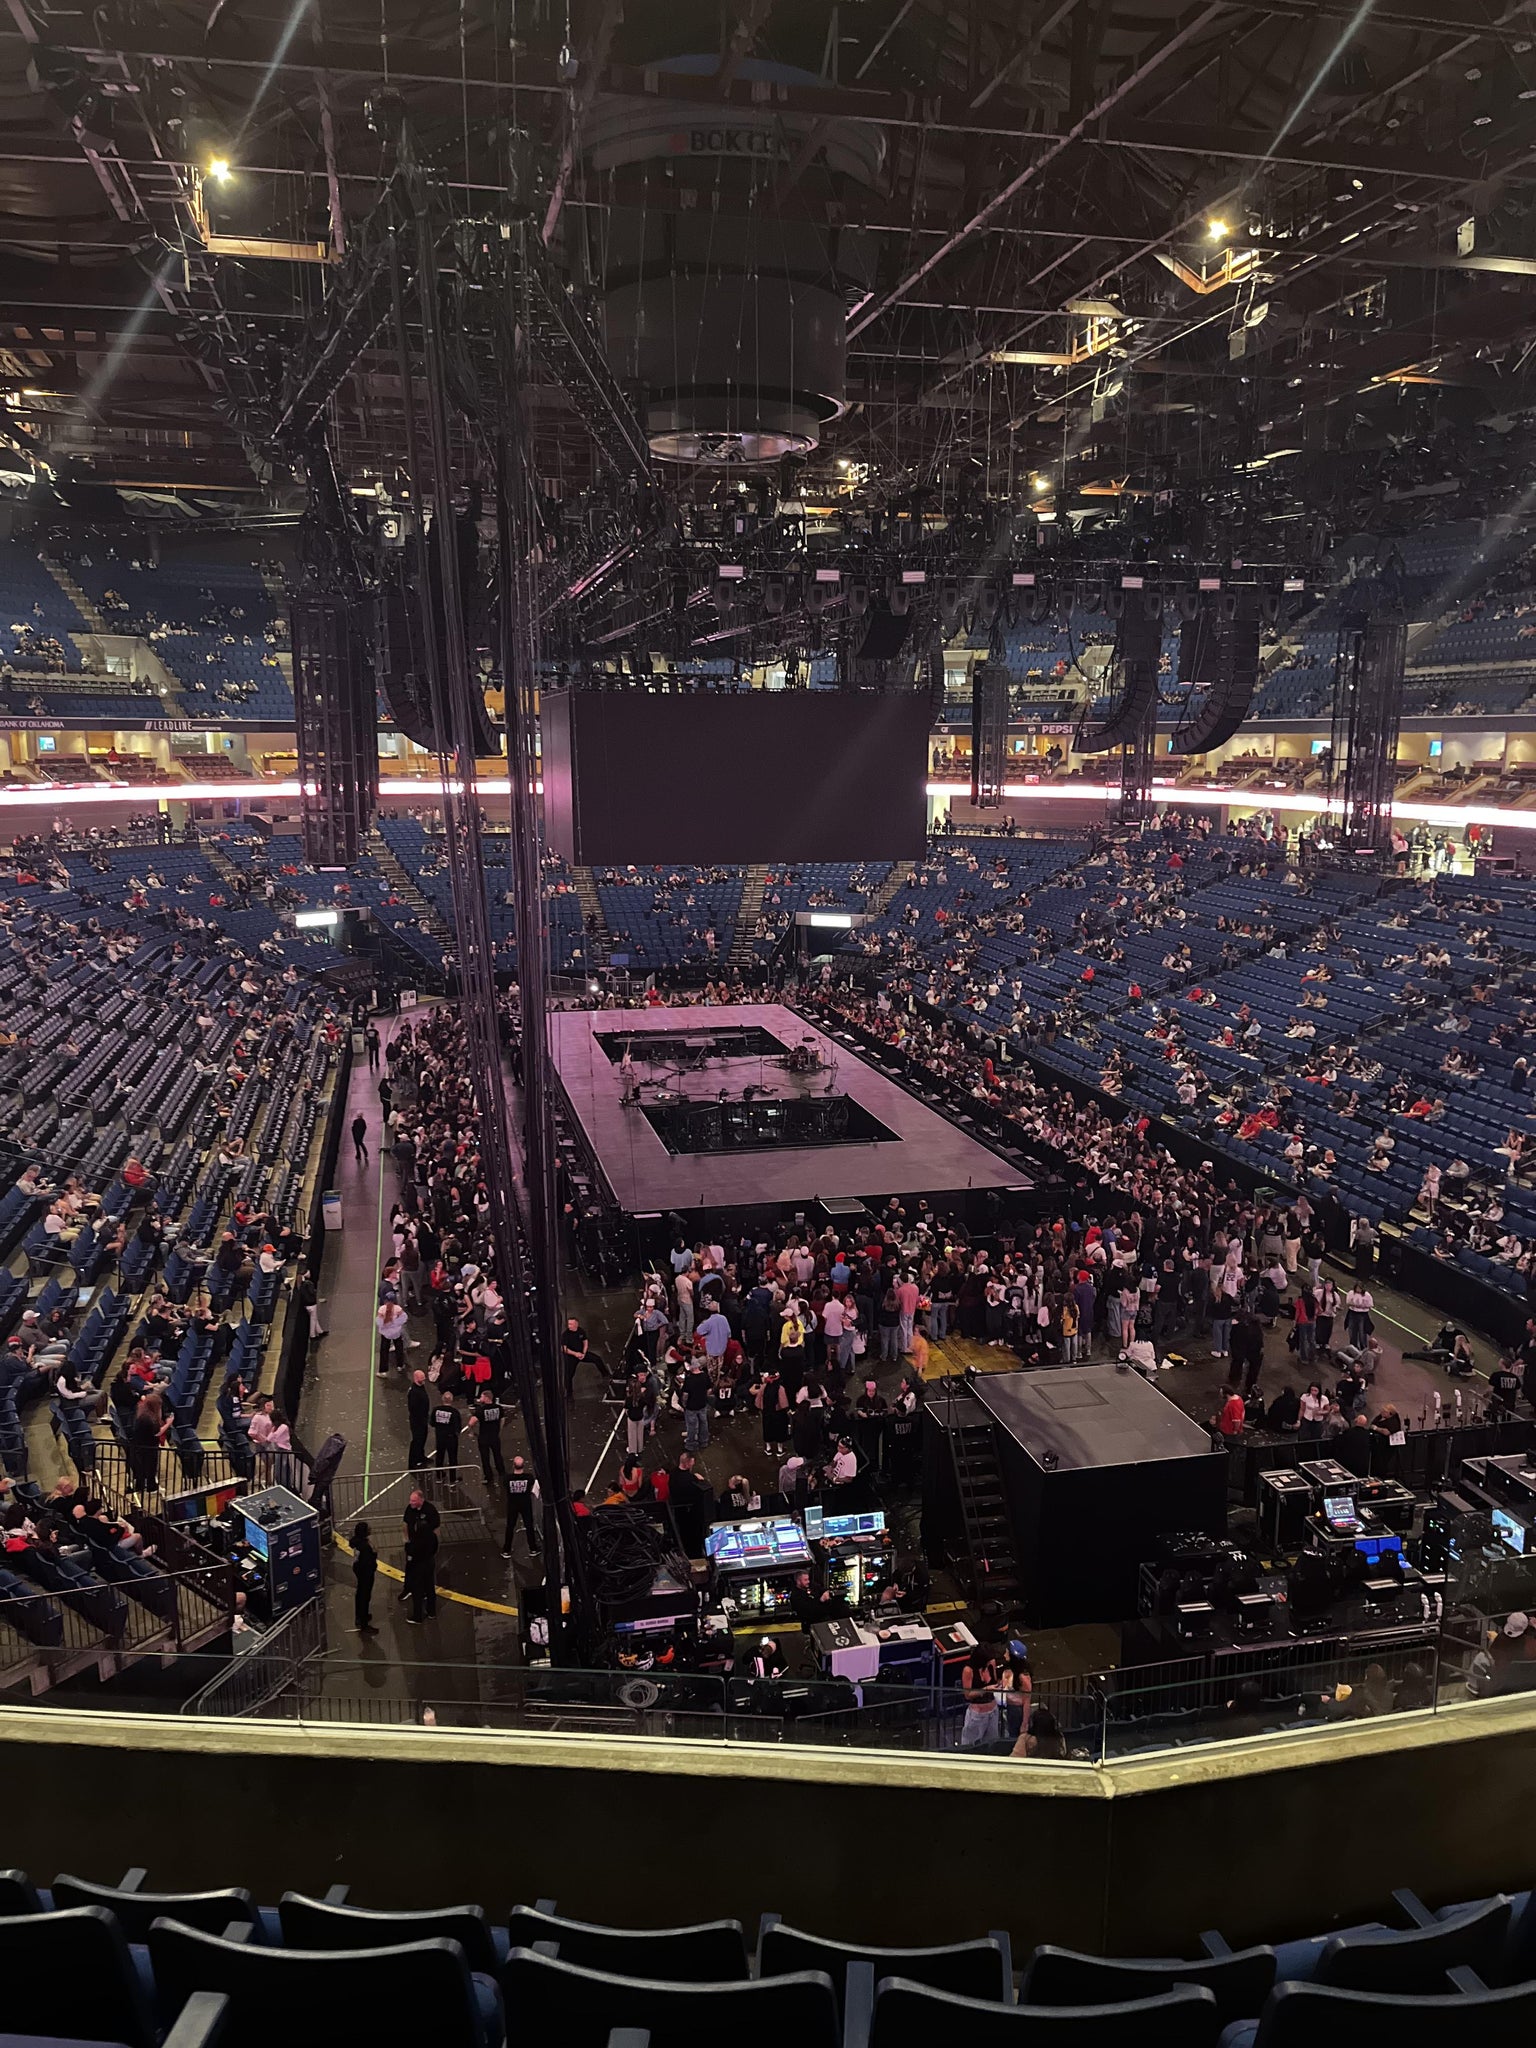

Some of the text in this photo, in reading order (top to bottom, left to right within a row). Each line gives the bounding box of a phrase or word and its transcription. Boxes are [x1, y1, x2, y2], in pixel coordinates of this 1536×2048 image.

[690, 129, 740, 152] BOK
[19, 720, 28, 728] OF
[28, 720, 65, 729] OKLAHOMA
[153, 721, 193, 731] LEADLINE
[1042, 725, 1073, 734] PEPSI
[719, 1387, 732, 1399] 87
[509, 1479, 528, 1488] EVENT
[510, 1486, 527, 1494] STAFF
